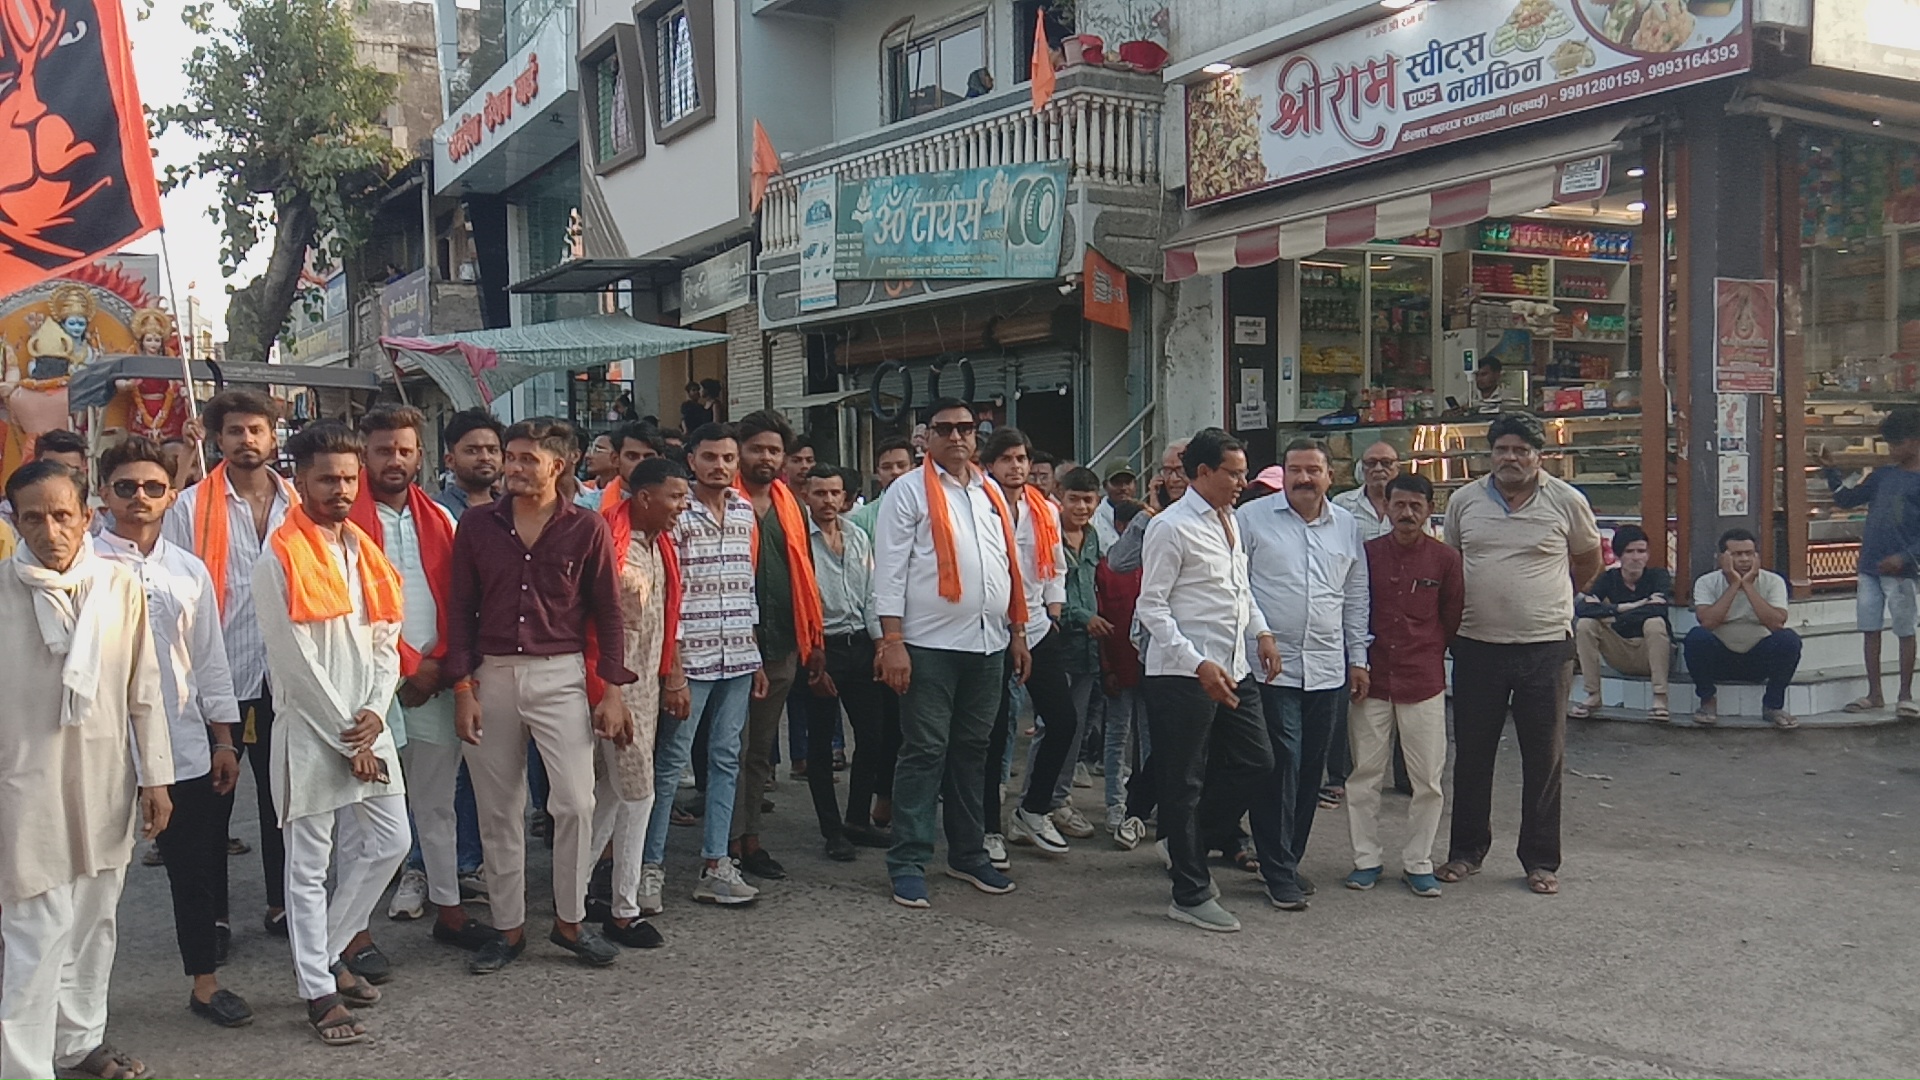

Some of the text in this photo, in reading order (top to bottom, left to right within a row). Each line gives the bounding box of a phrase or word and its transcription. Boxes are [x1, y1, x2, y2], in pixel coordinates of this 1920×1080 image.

[1405, 32, 1487, 83] स्वीट्स
[1559, 69, 1645, 102] 9981280159,
[1648, 43, 1739, 80] 9993164393
[1408, 86, 1438, 108] एण्ड
